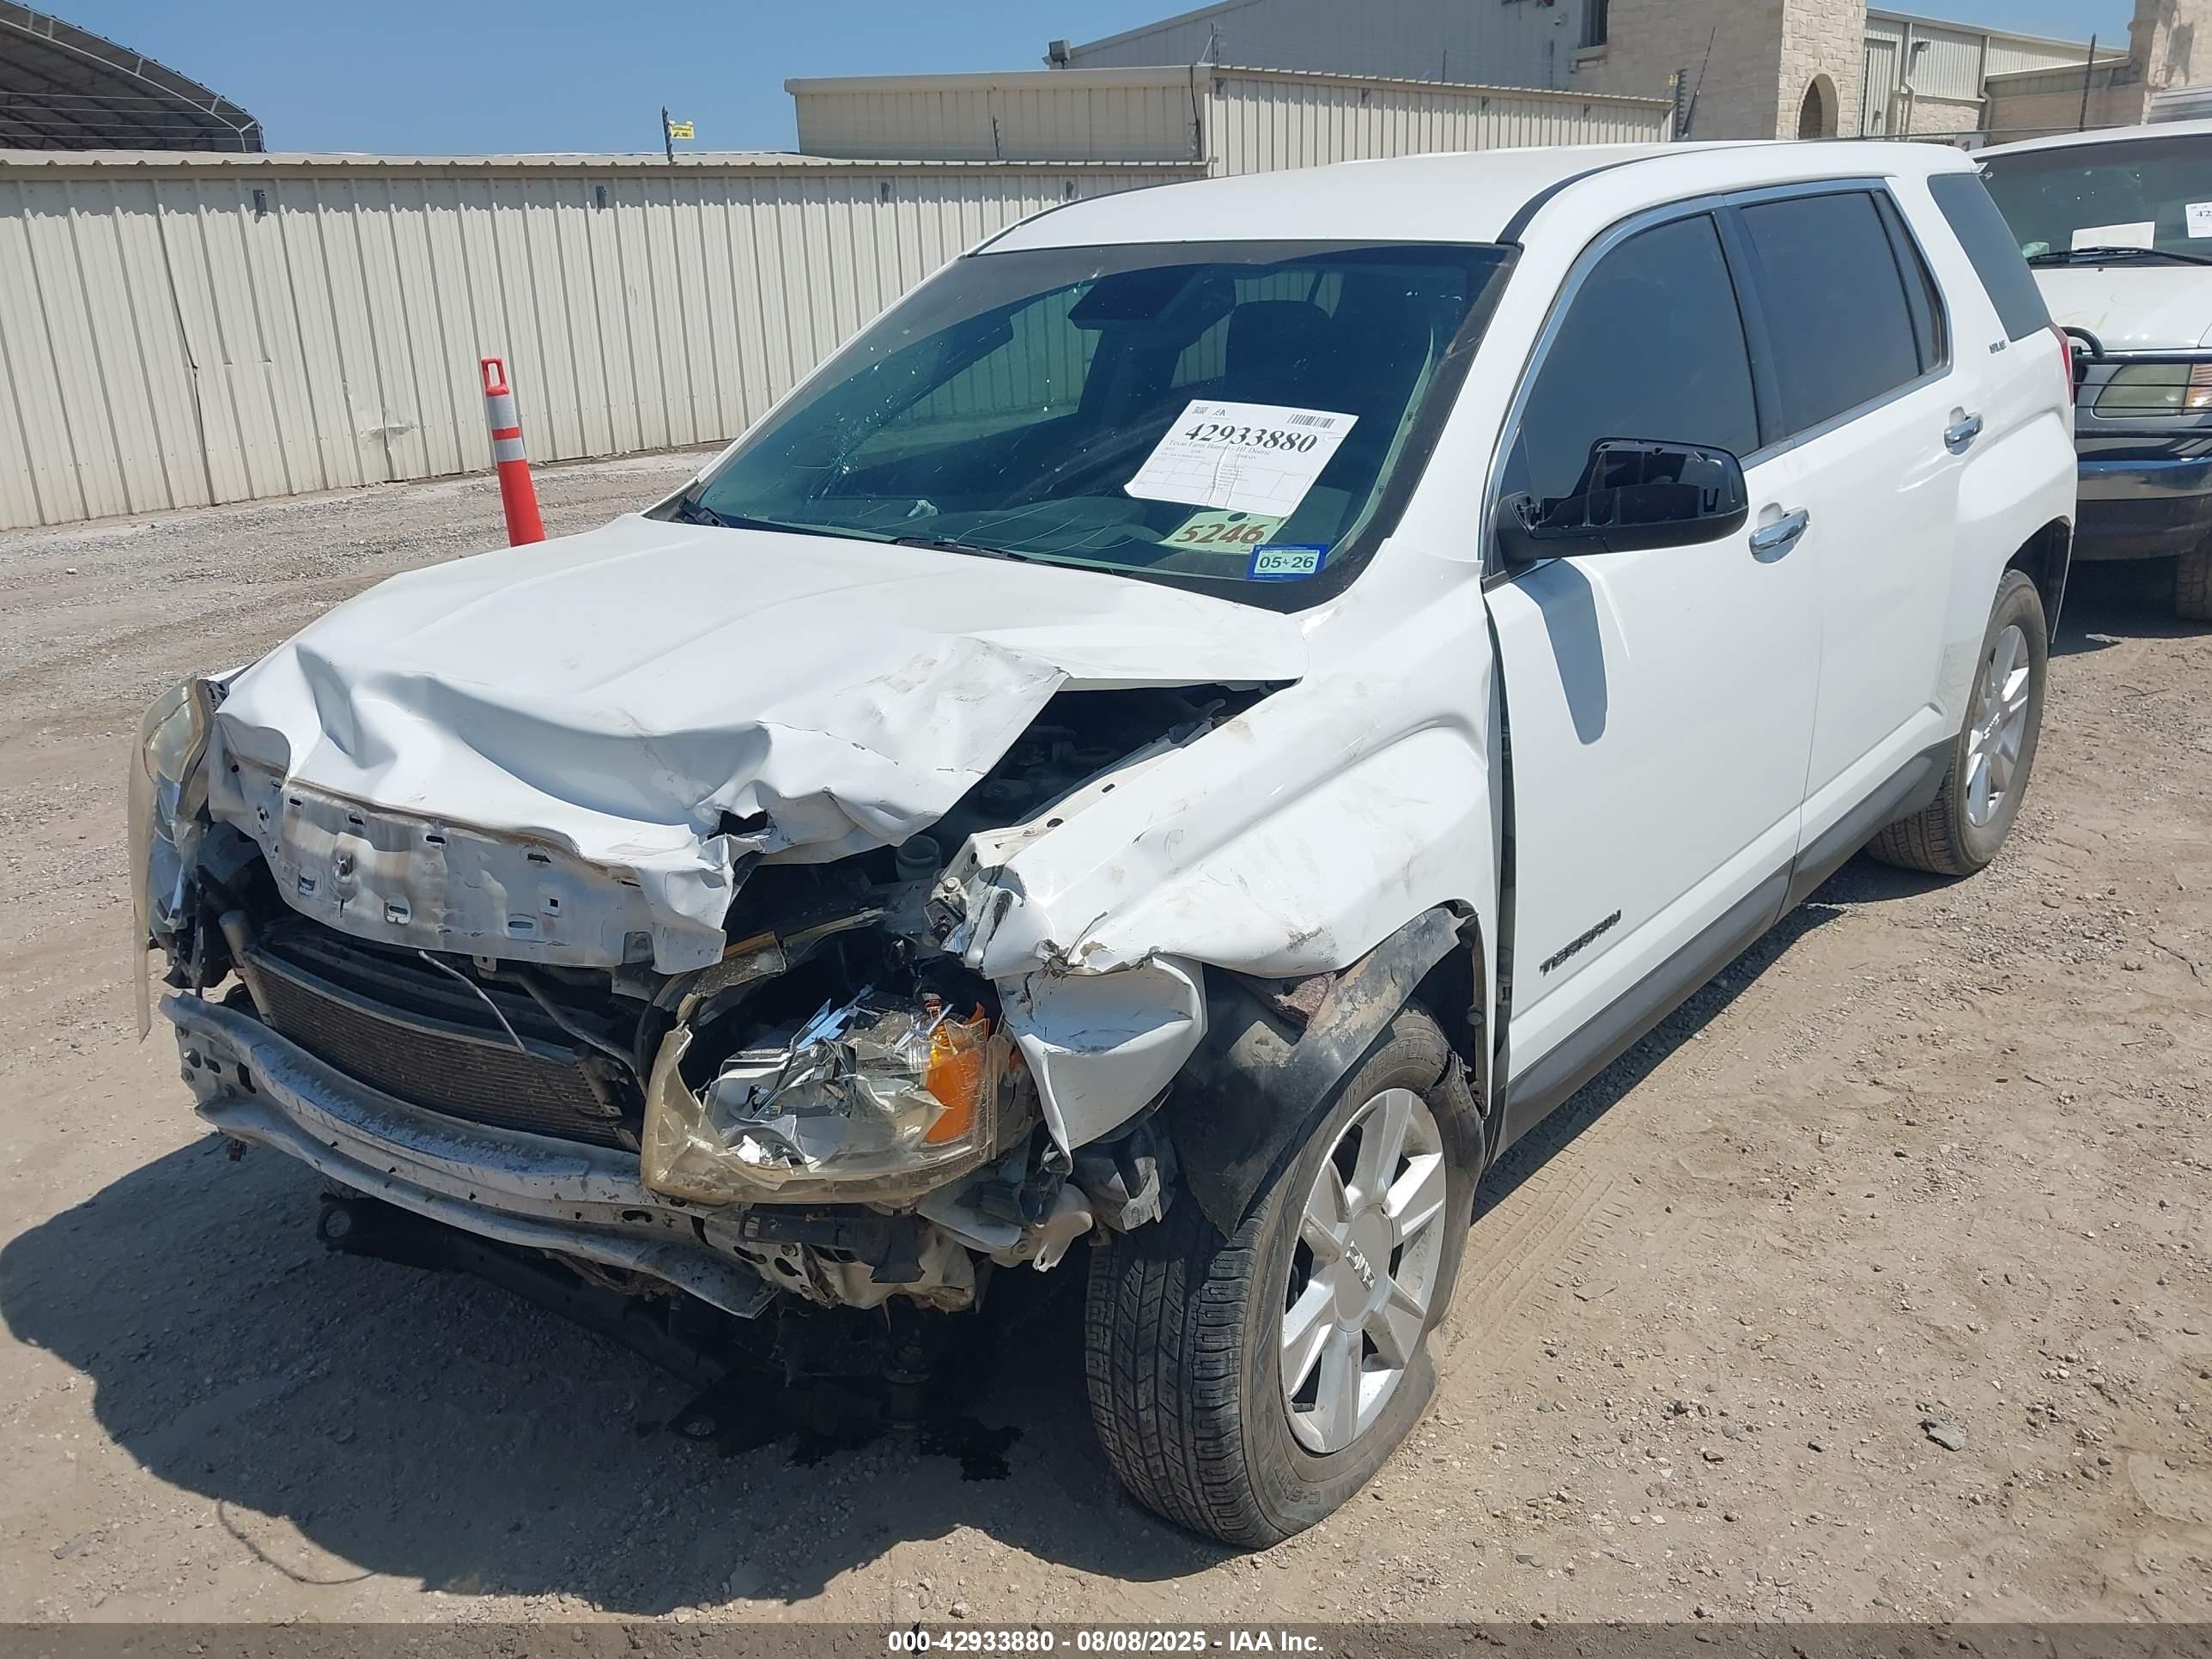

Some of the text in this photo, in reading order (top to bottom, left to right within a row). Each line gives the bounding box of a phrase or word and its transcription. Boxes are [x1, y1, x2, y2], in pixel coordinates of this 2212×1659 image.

[1185, 423, 1318, 453] 42933880
[1174, 524, 1268, 544] 5246
[1259, 556, 1315, 568] 05 26
